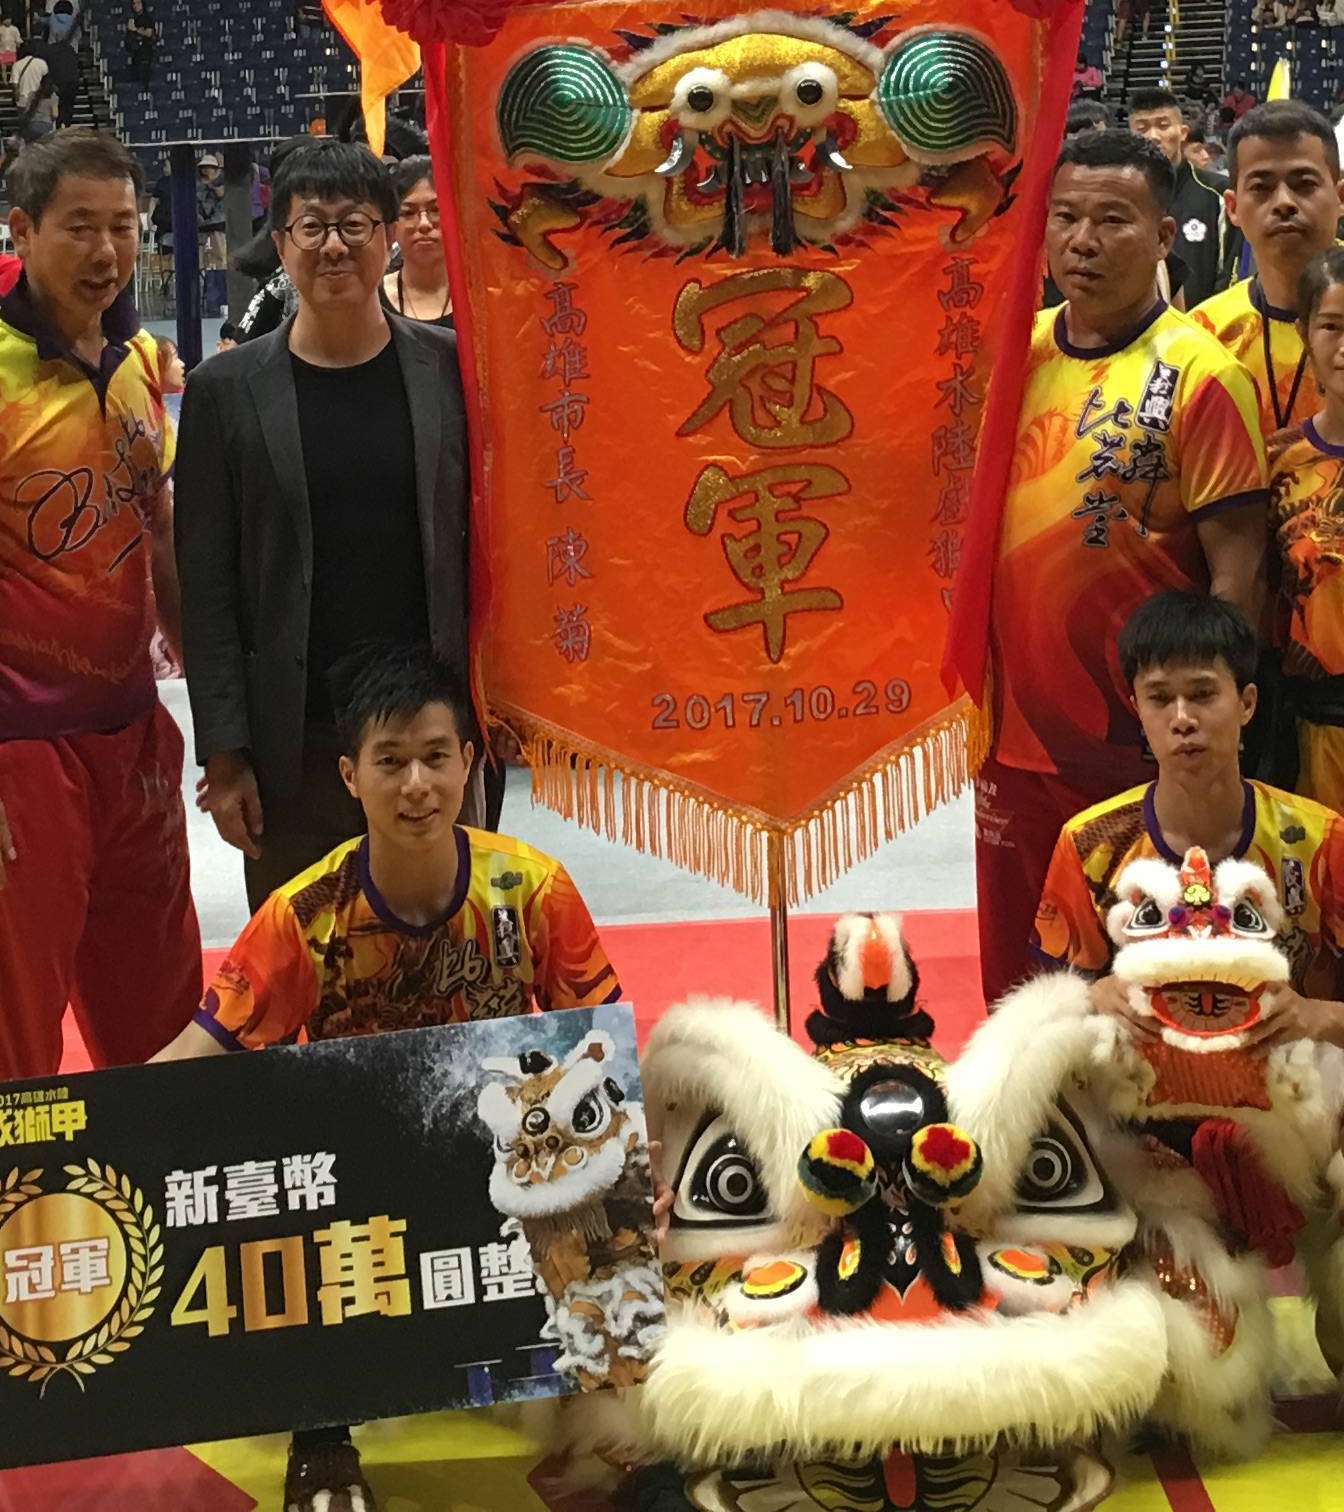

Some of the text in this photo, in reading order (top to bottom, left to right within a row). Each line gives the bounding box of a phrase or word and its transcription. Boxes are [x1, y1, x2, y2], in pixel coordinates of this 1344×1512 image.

[671, 266, 855, 665] 冠軍
[650, 678, 913, 730] 2017.10.29
[164, 1151, 338, 1228] 新臺幣
[3, 1236, 112, 1303] 冠軍
